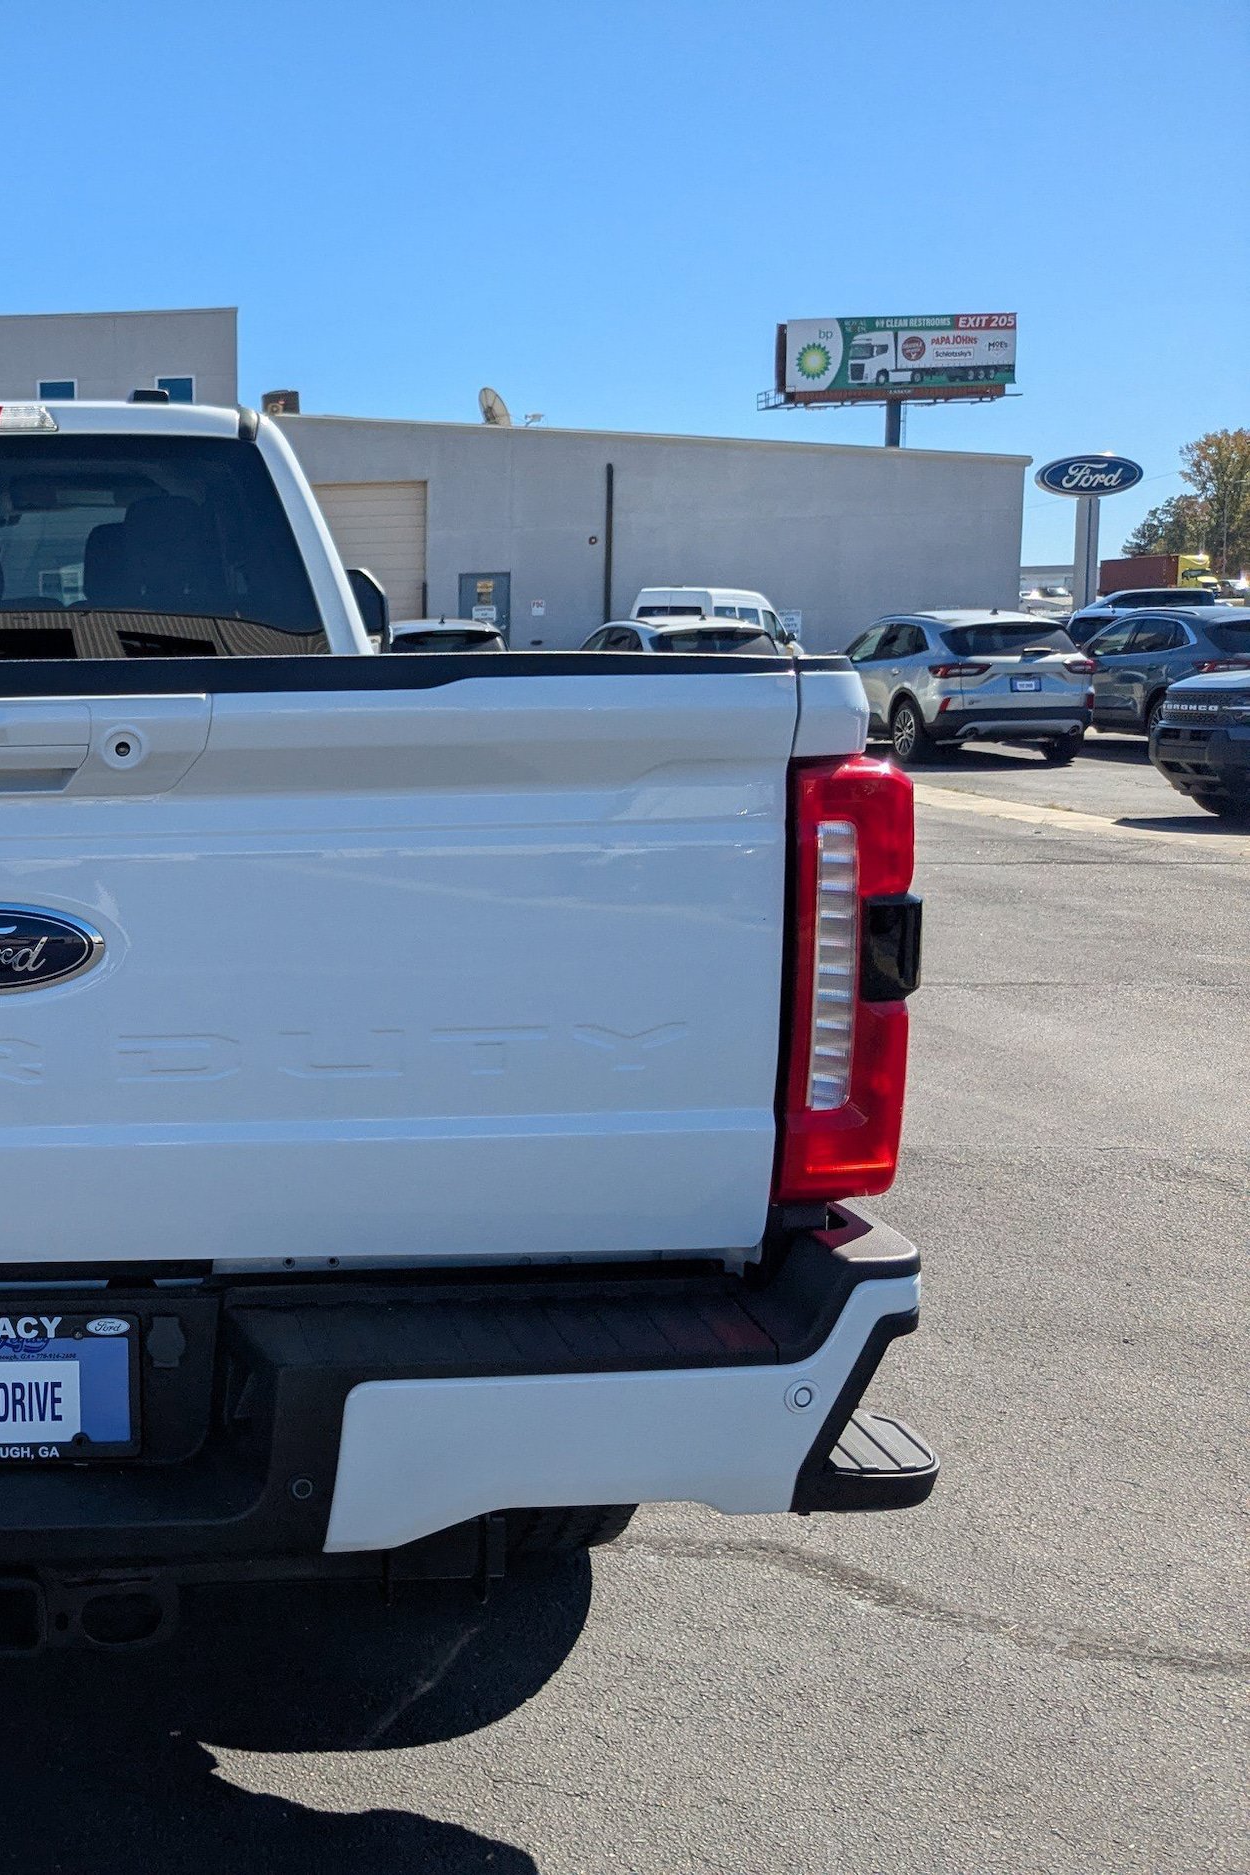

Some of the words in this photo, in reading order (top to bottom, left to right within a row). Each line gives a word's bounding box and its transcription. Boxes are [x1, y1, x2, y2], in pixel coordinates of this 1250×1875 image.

[886, 318, 908, 328] CLEAN
[909, 316, 951, 327] RESTROOMS
[958, 316, 989, 328] EXIT
[989, 315, 1015, 327] 205
[818, 329, 833, 341] bp
[1062, 463, 1123, 488] Ford
[1164, 703, 1218, 711] BRONCO
[117, 1021, 688, 1083] DUTY
[94, 1319, 121, 1332] Ford
[38, 1446, 60, 1458] GA
